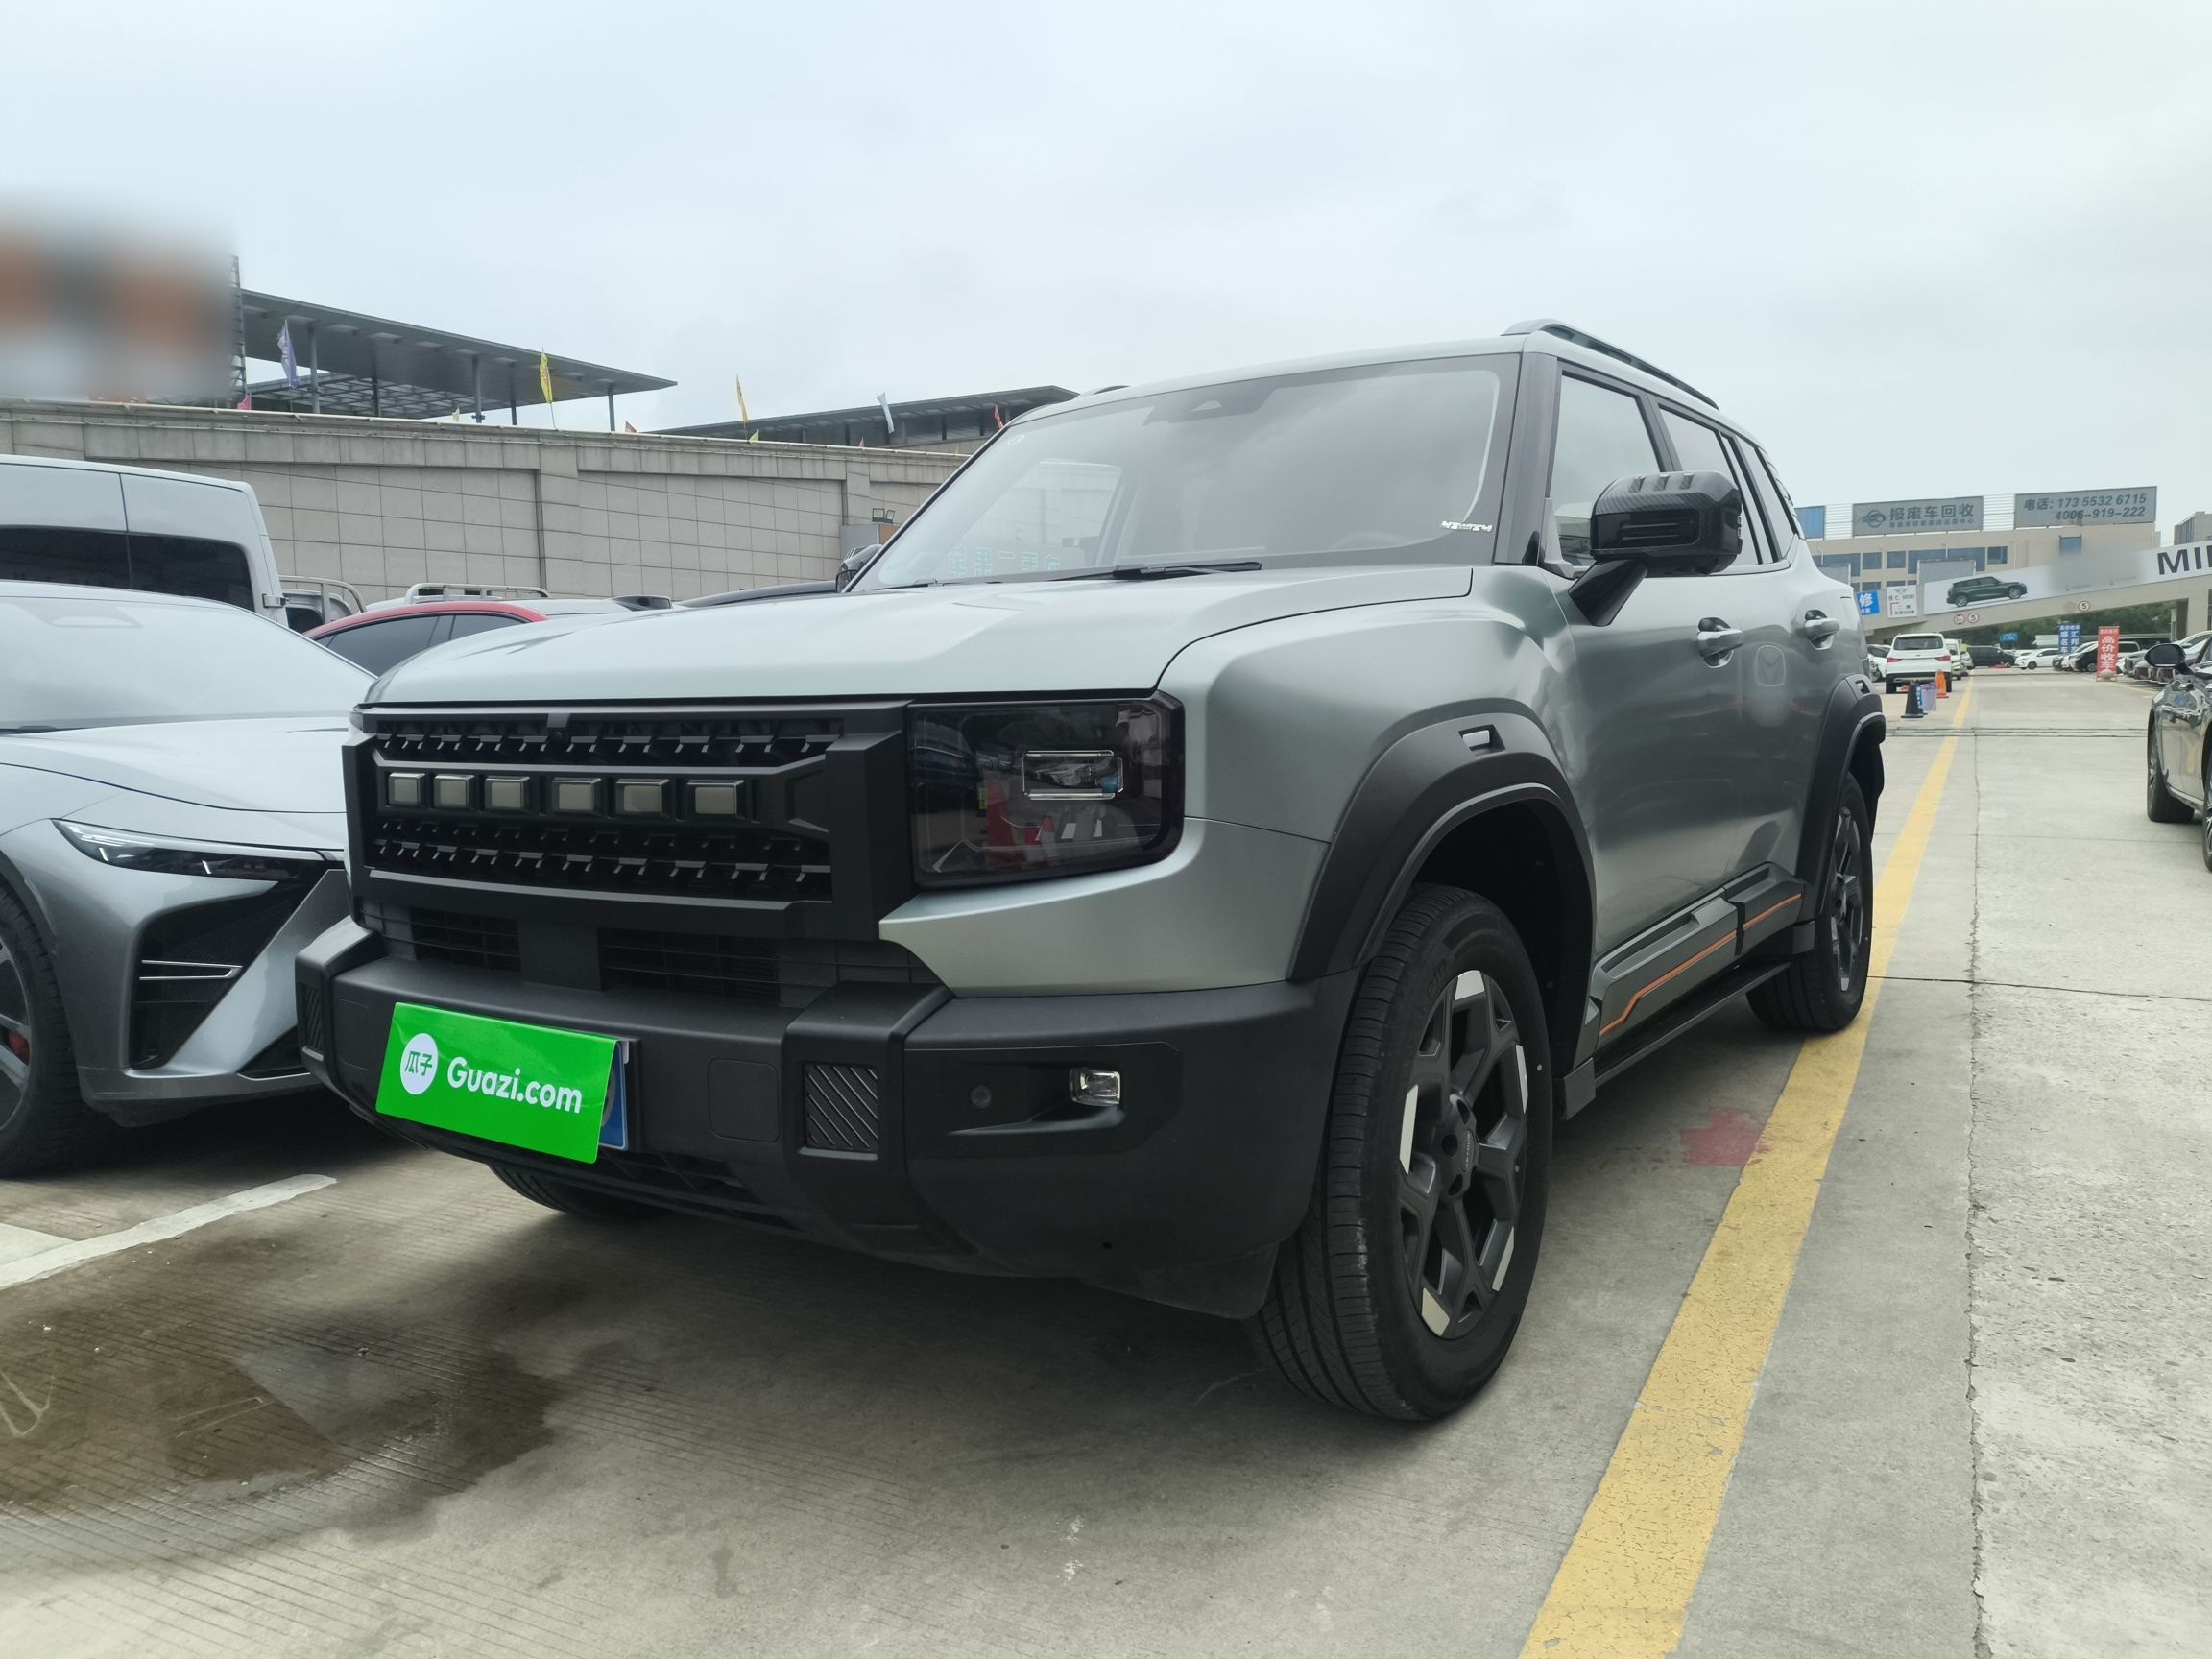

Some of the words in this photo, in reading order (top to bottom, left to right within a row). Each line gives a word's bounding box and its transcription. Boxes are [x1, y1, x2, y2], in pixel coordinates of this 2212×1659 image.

[1889, 503, 1975, 521] 报废车回收
[2057, 497, 2080, 508] 173
[2081, 495, 2113, 507] 5532
[2115, 493, 2148, 506] 6715
[2100, 636, 2116, 670] 高价收车
[404, 1050, 432, 1076] 瓜子
[446, 1056, 583, 1114] Guazi.com
